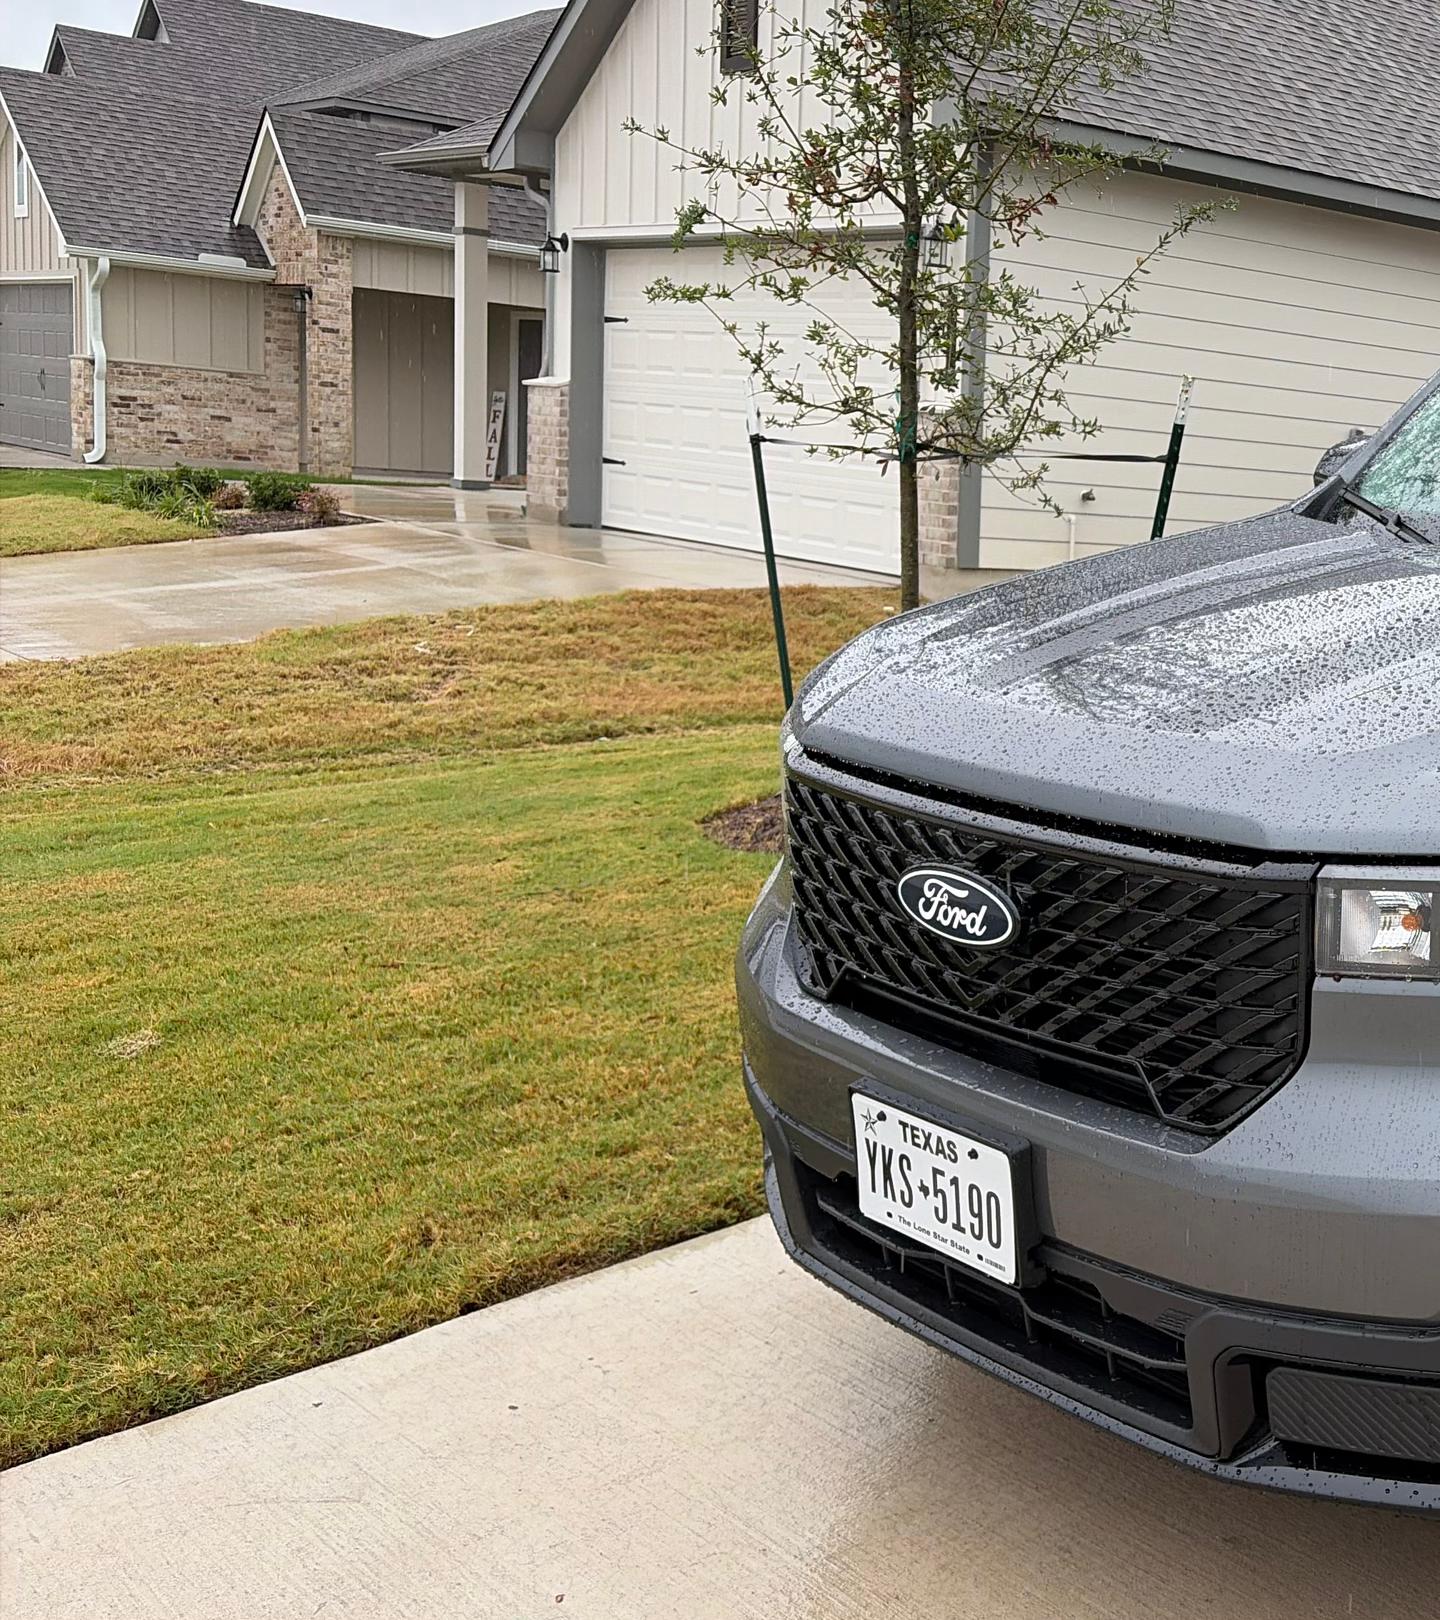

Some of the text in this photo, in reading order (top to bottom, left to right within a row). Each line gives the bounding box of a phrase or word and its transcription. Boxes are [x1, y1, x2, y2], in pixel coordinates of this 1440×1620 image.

[486, 409, 502, 478] FALL
[919, 879, 987, 936] Ford
[899, 1120, 959, 1164] TEXAS
[865, 1138, 1002, 1250] YKS 5190
[897, 1215, 971, 1256] The Lone Star State
